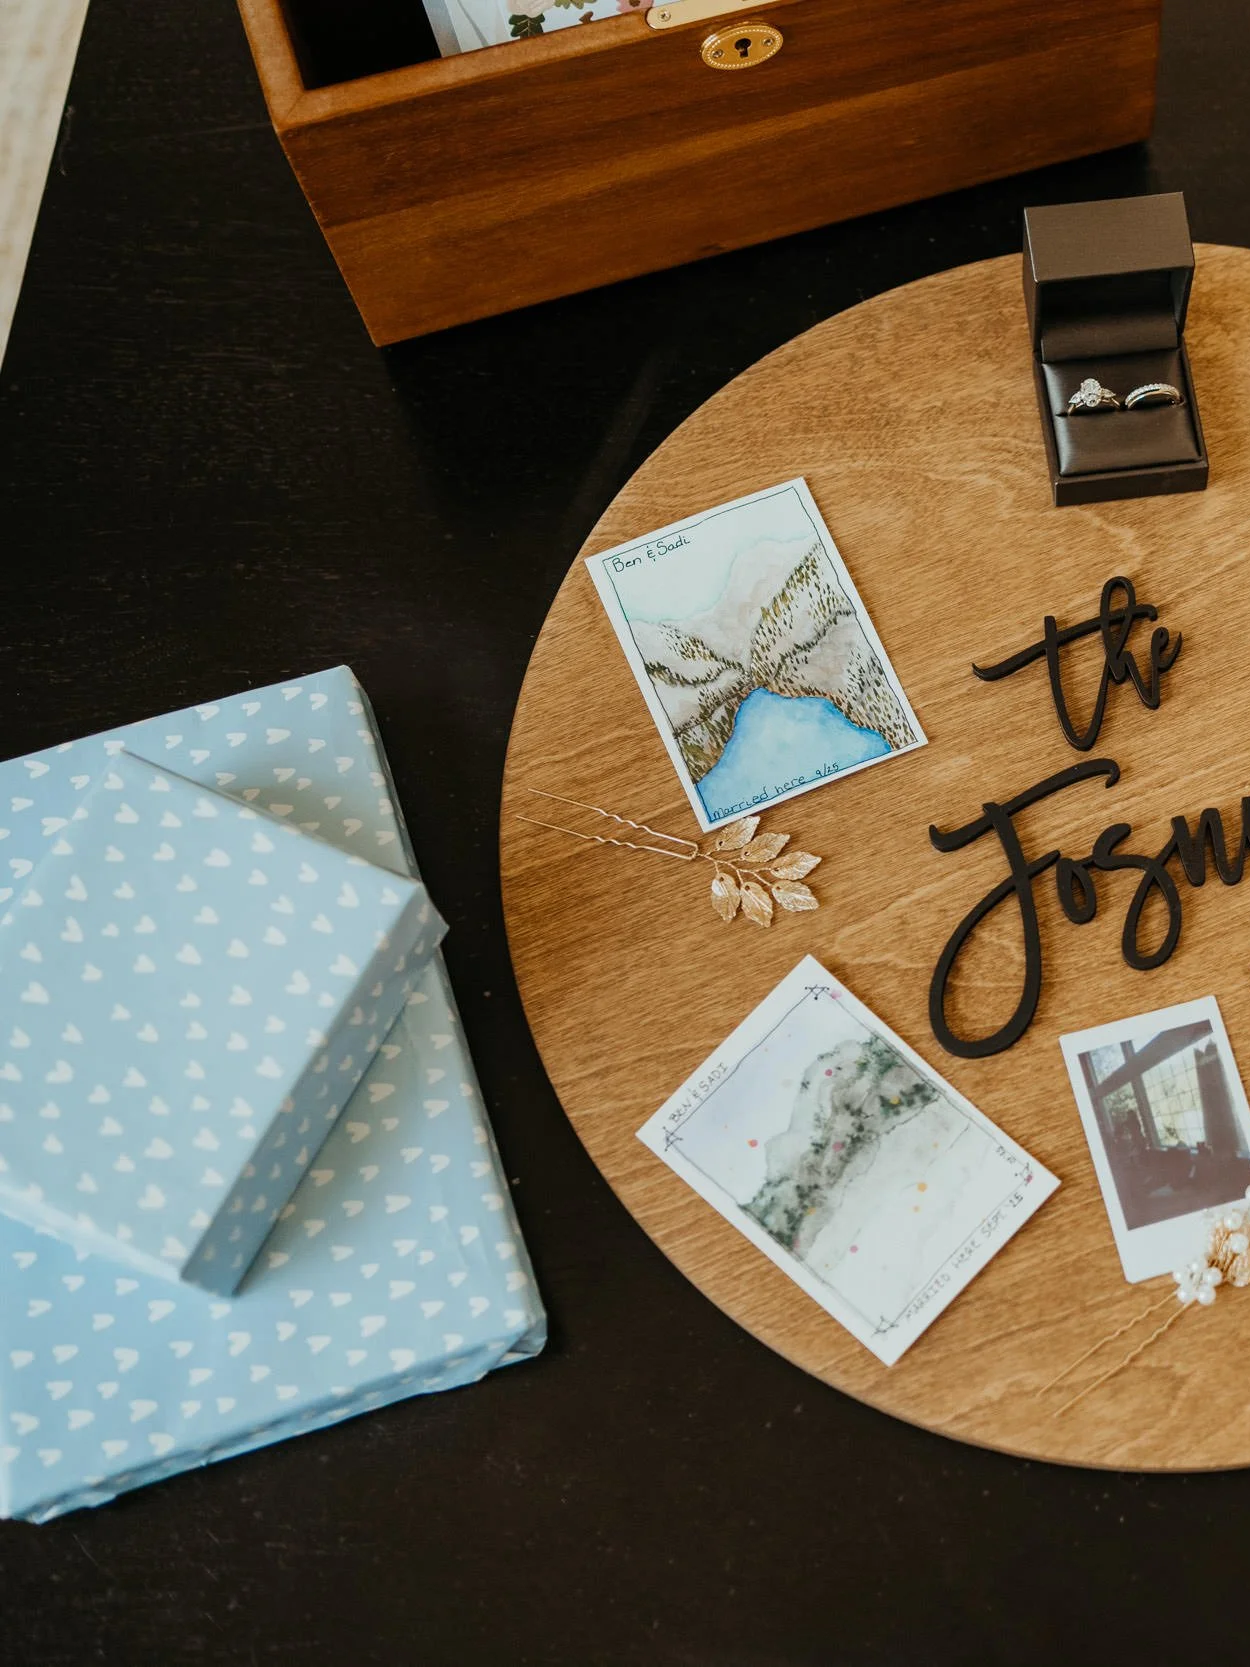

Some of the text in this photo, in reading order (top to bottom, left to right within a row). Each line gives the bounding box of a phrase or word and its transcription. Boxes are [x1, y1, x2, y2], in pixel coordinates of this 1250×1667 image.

[611, 555, 642, 574] Ben
[656, 535, 691, 557] Sadi
[972, 575, 1183, 752] the
[774, 774, 806, 795] here
[815, 761, 840, 779] 9/25
[699, 1062, 729, 1094] SADI
